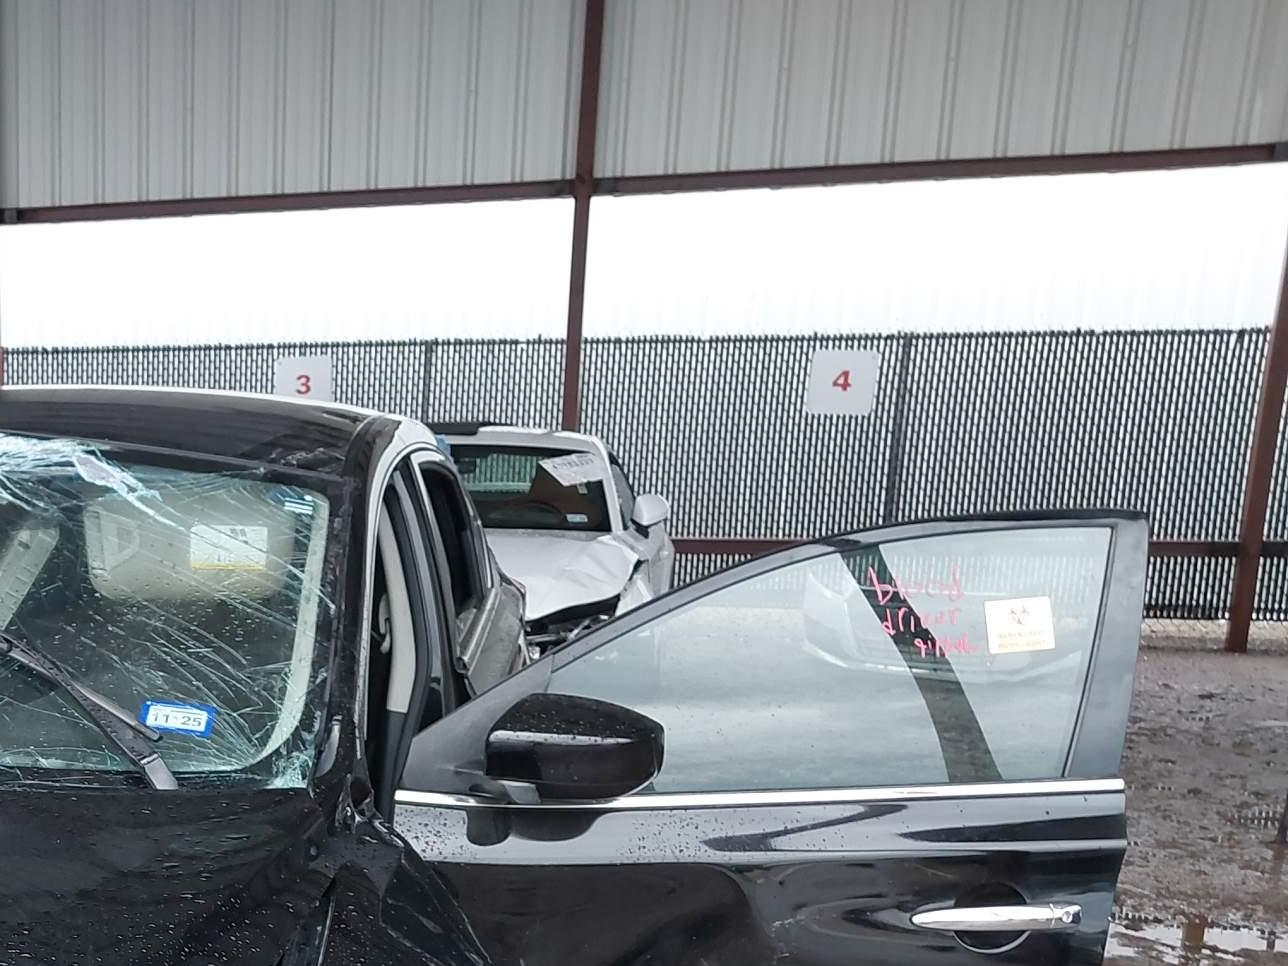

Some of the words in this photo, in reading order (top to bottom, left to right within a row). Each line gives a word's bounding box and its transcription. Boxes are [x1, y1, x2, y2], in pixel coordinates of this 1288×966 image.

[295, 374, 311, 395] 3
[832, 370, 852, 391] 4
[180, 715, 203, 727] 25
